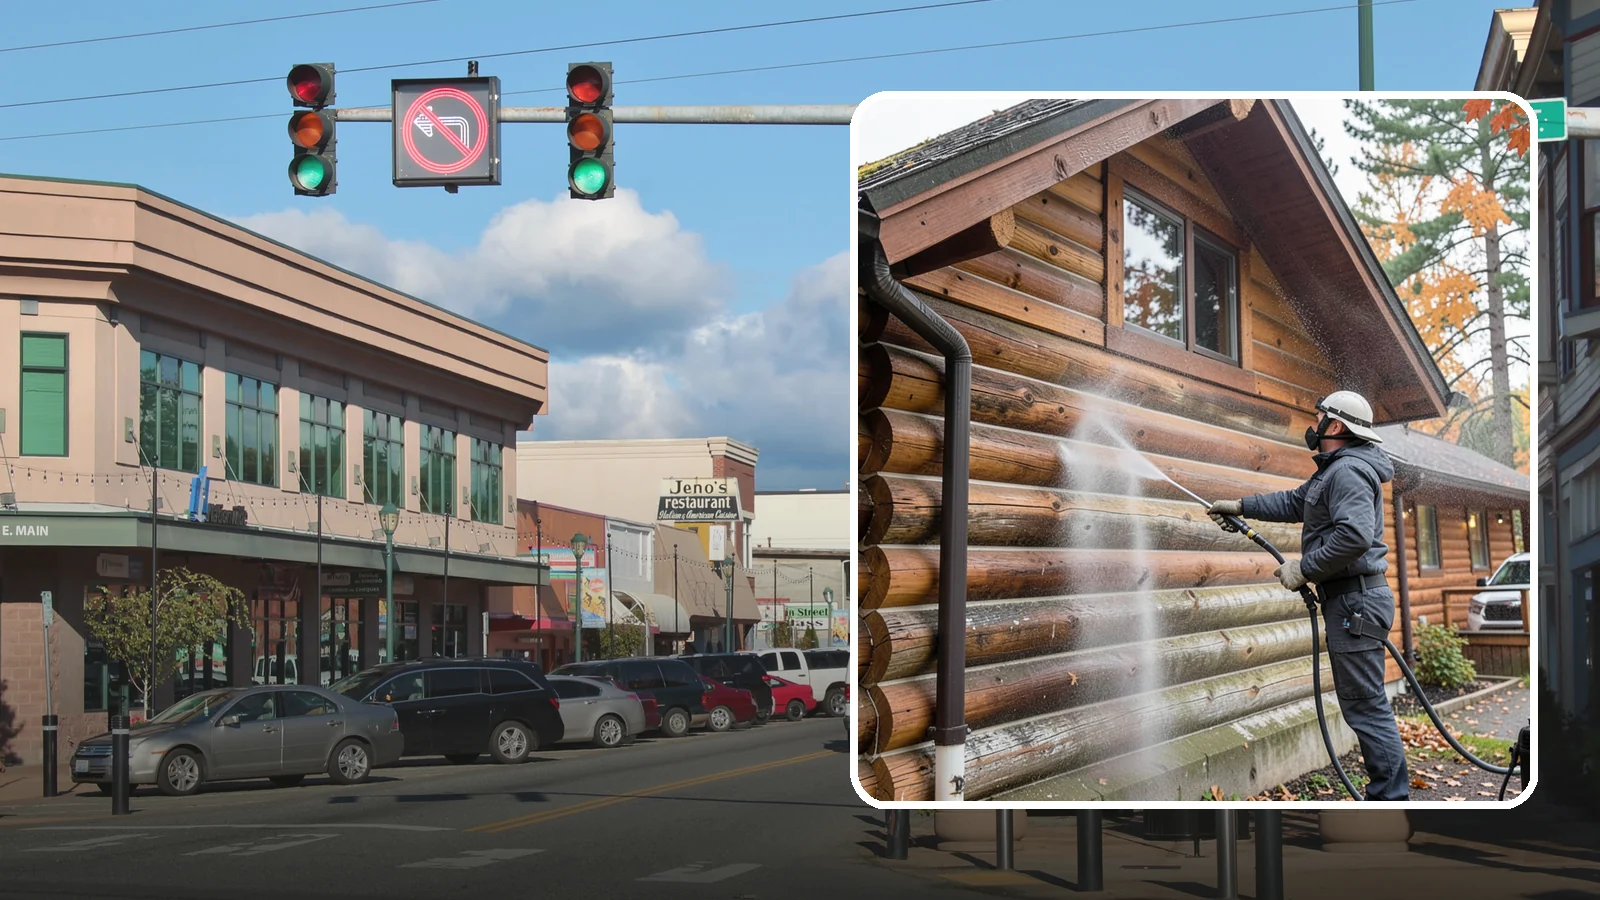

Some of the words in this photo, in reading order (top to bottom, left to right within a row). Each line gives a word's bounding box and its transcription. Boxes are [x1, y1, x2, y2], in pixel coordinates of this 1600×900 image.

[670, 480, 727, 494] Jeno's
[665, 496, 731, 509] restaurant
[659, 510, 681, 519] Italian
[686, 510, 714, 519] American
[715, 509, 737, 519] Cuisine
[2, 525, 13, 536] E.
[15, 525, 49, 536] MAIN
[797, 607, 828, 616] Street
[790, 619, 823, 627] lass
